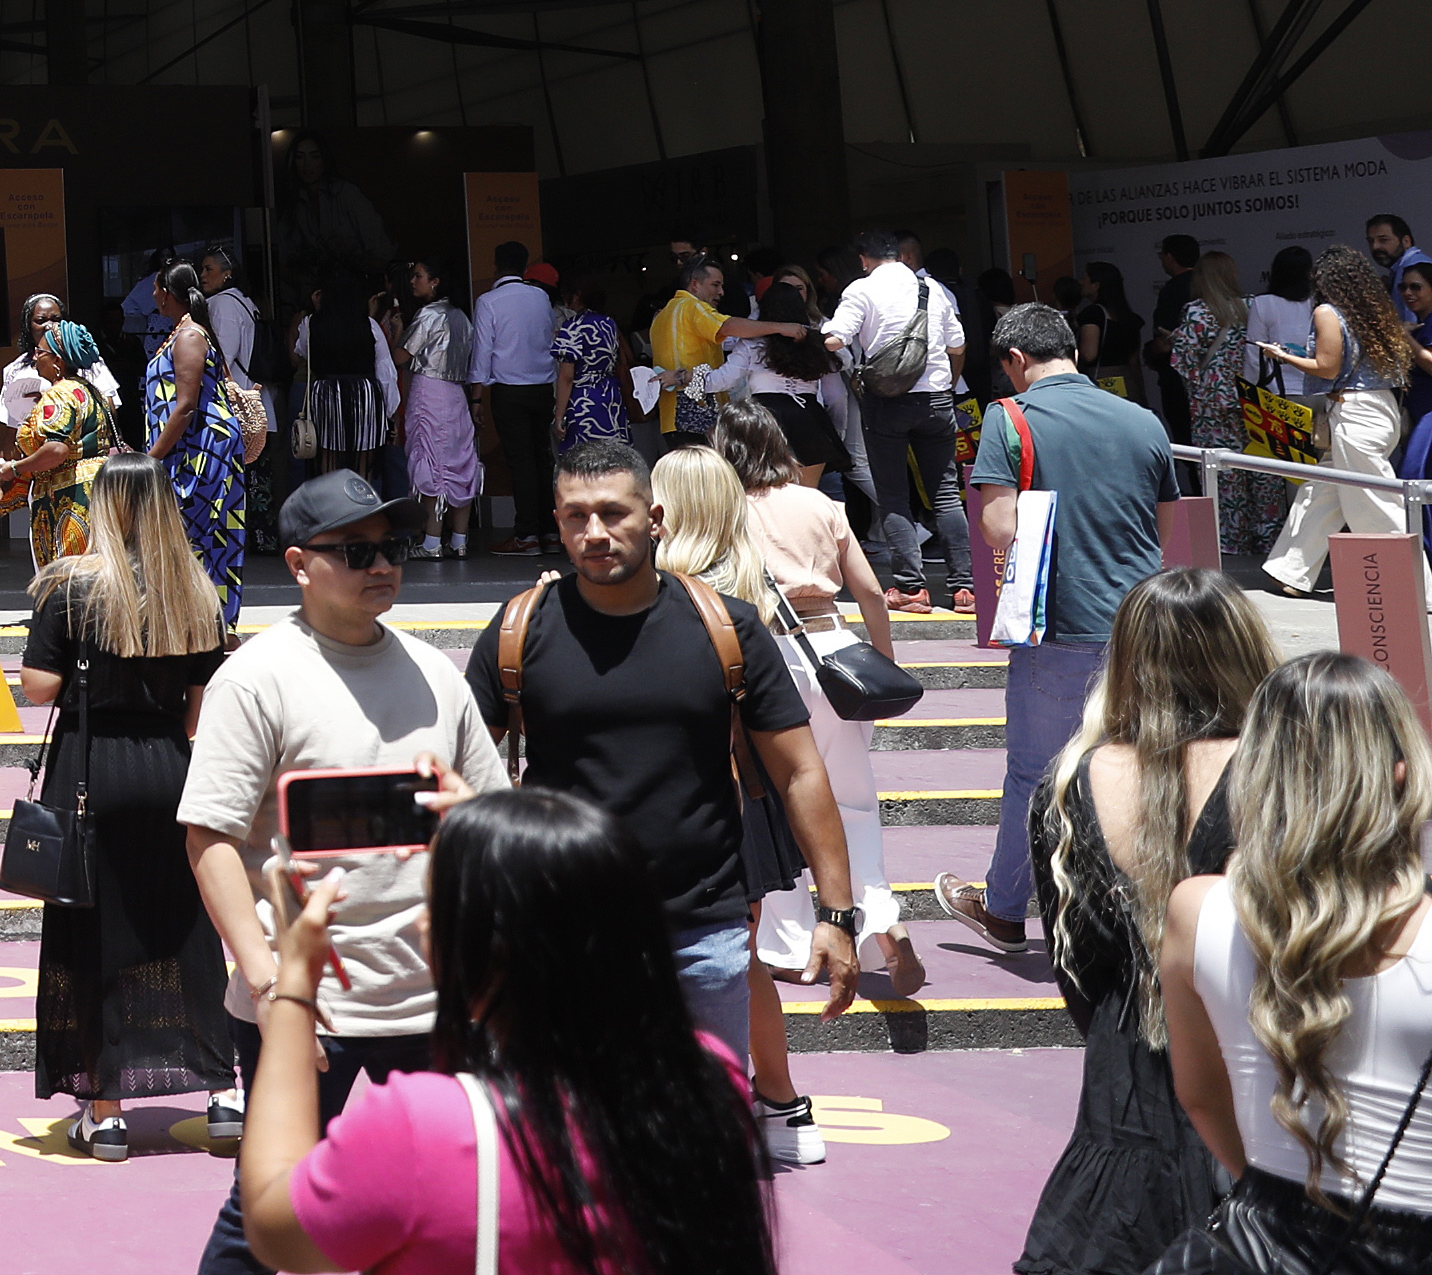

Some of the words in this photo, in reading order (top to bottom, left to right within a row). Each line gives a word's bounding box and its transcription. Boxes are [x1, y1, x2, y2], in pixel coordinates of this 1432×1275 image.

[1078, 188, 1093, 205] DE
[1097, 185, 1116, 203] LAS
[1119, 179, 1179, 202] ALIANZAS
[1183, 176, 1217, 195] HACE
[1220, 170, 1265, 191] VIBRAR
[1268, 168, 1284, 186] EL
[1287, 163, 1340, 184] SISTEMA
[1343, 159, 1388, 179] MODA
[1097, 209, 1153, 230] ¡PORQUE
[1156, 204, 1189, 222] SOLO
[1191, 199, 1241, 221] JUNTOS
[1245, 193, 1300, 213] SOMOS!
[1362, 552, 1390, 672] ONSCIENCIA
